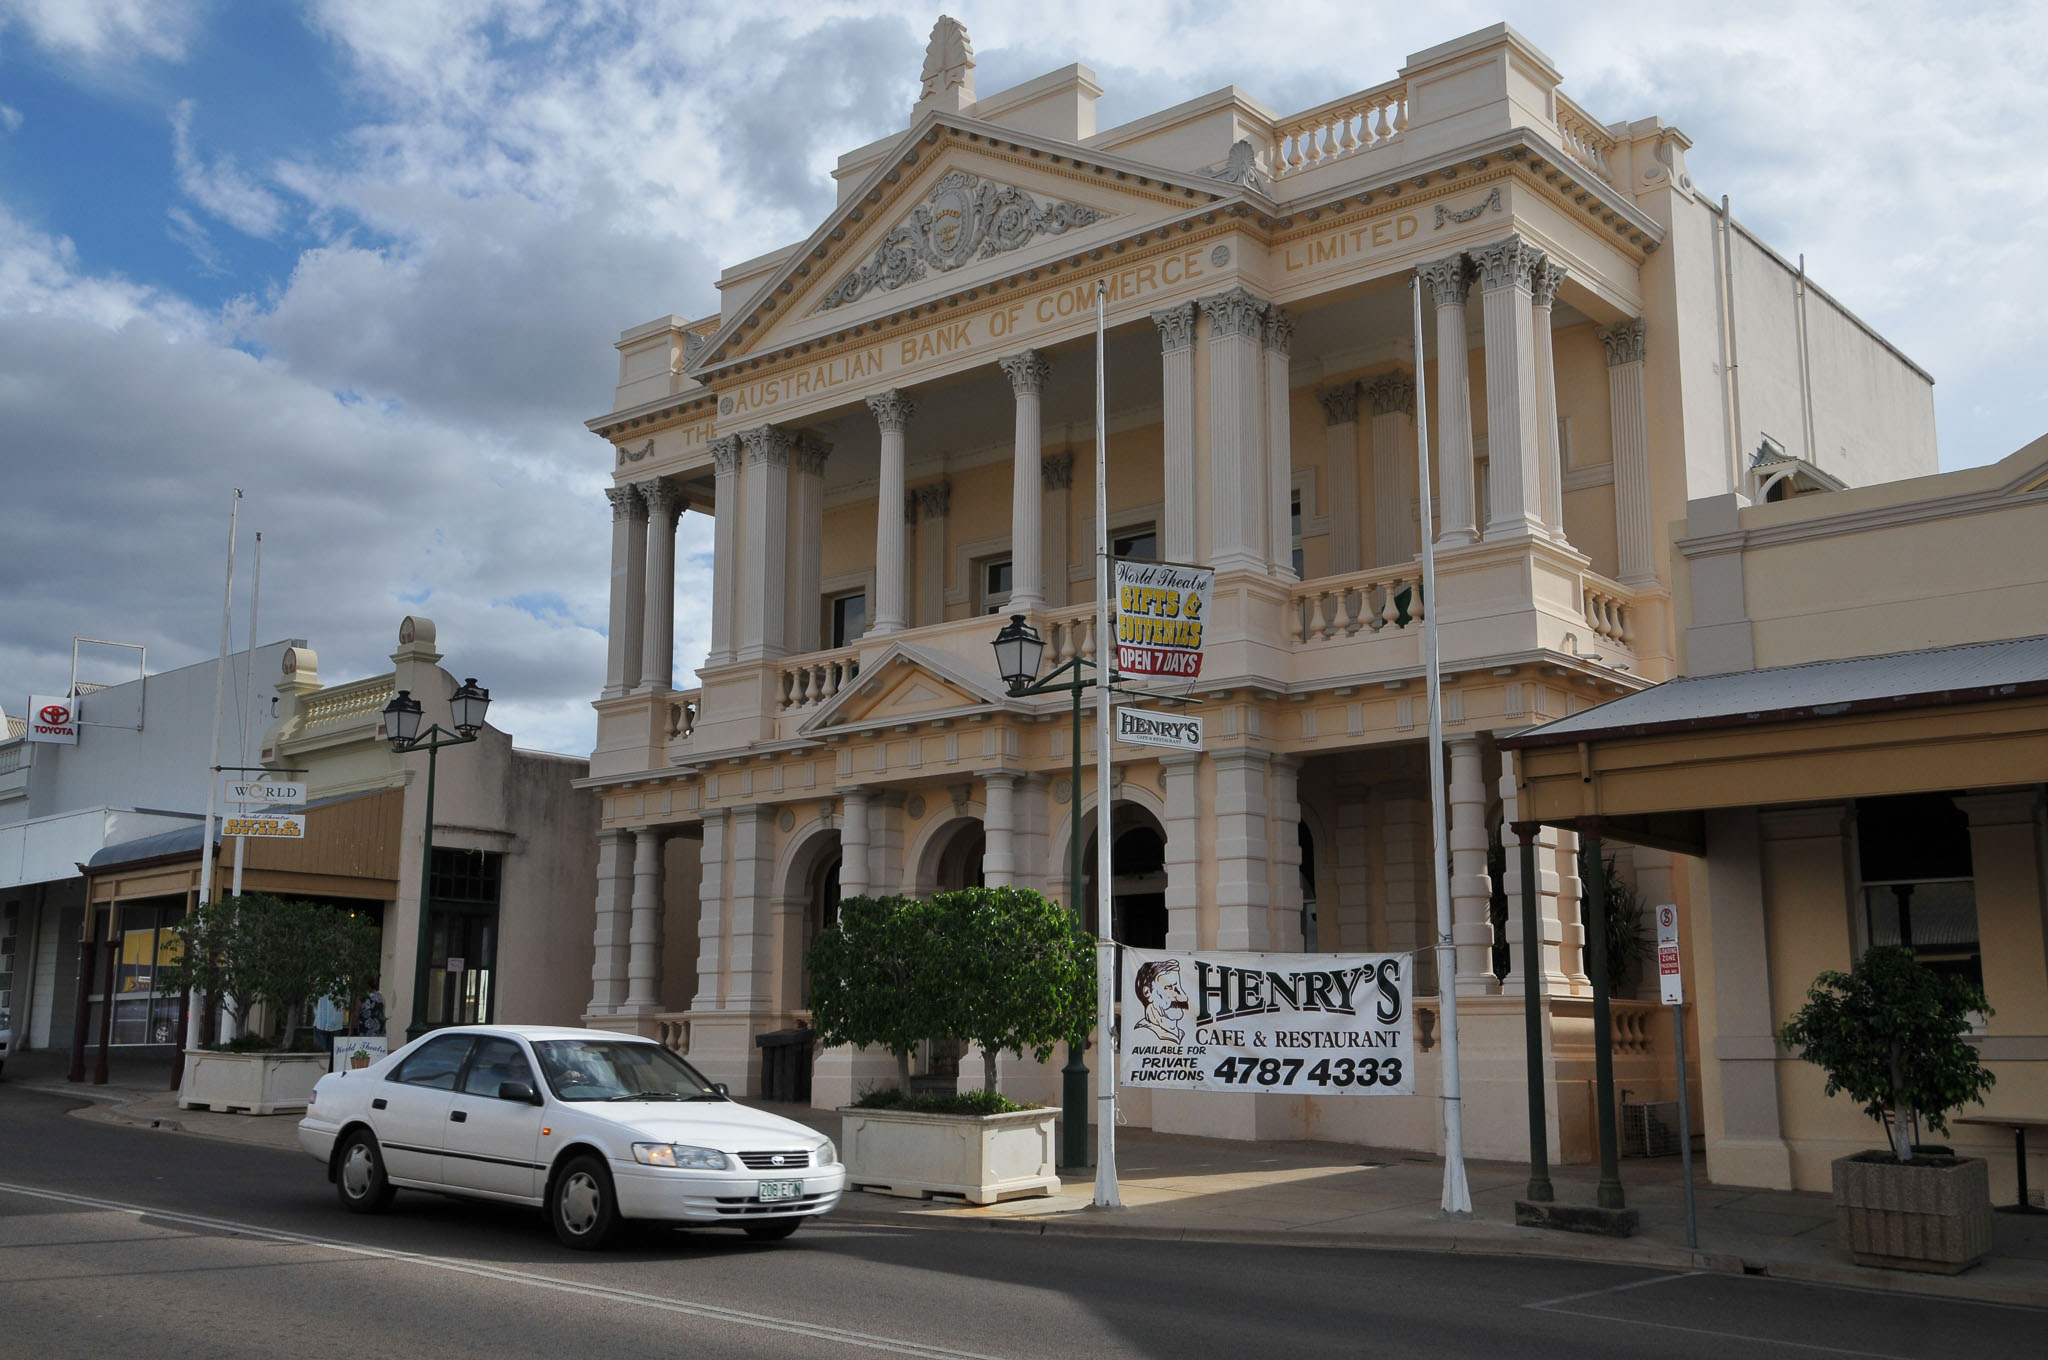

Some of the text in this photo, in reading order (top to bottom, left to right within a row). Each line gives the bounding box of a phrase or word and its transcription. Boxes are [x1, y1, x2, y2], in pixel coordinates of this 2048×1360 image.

[1285, 215, 1418, 272] LIMITED
[734, 248, 1204, 413] AUSTRALIAN BANK OF COMMERCE
[1116, 564, 1207, 590] World Theatre
[1121, 585, 1202, 620] GIFTS &
[1120, 647, 1198, 674] OPEN 7 DAYS
[34, 725, 74, 736] TOYOTA
[1120, 712, 1200, 744] HENRY'S
[1662, 954, 1676, 962] ZONE
[1195, 959, 1402, 1027] HENRY'S
[1132, 1046, 1206, 1056] AVAILABLE FOR
[1195, 1029, 1400, 1048] CAFE & RESTAURANT
[1130, 1070, 1205, 1082] FUNCTIONS
[1141, 1057, 1198, 1069] PRIVATE
[1214, 1056, 1402, 1086] 4787 4333
